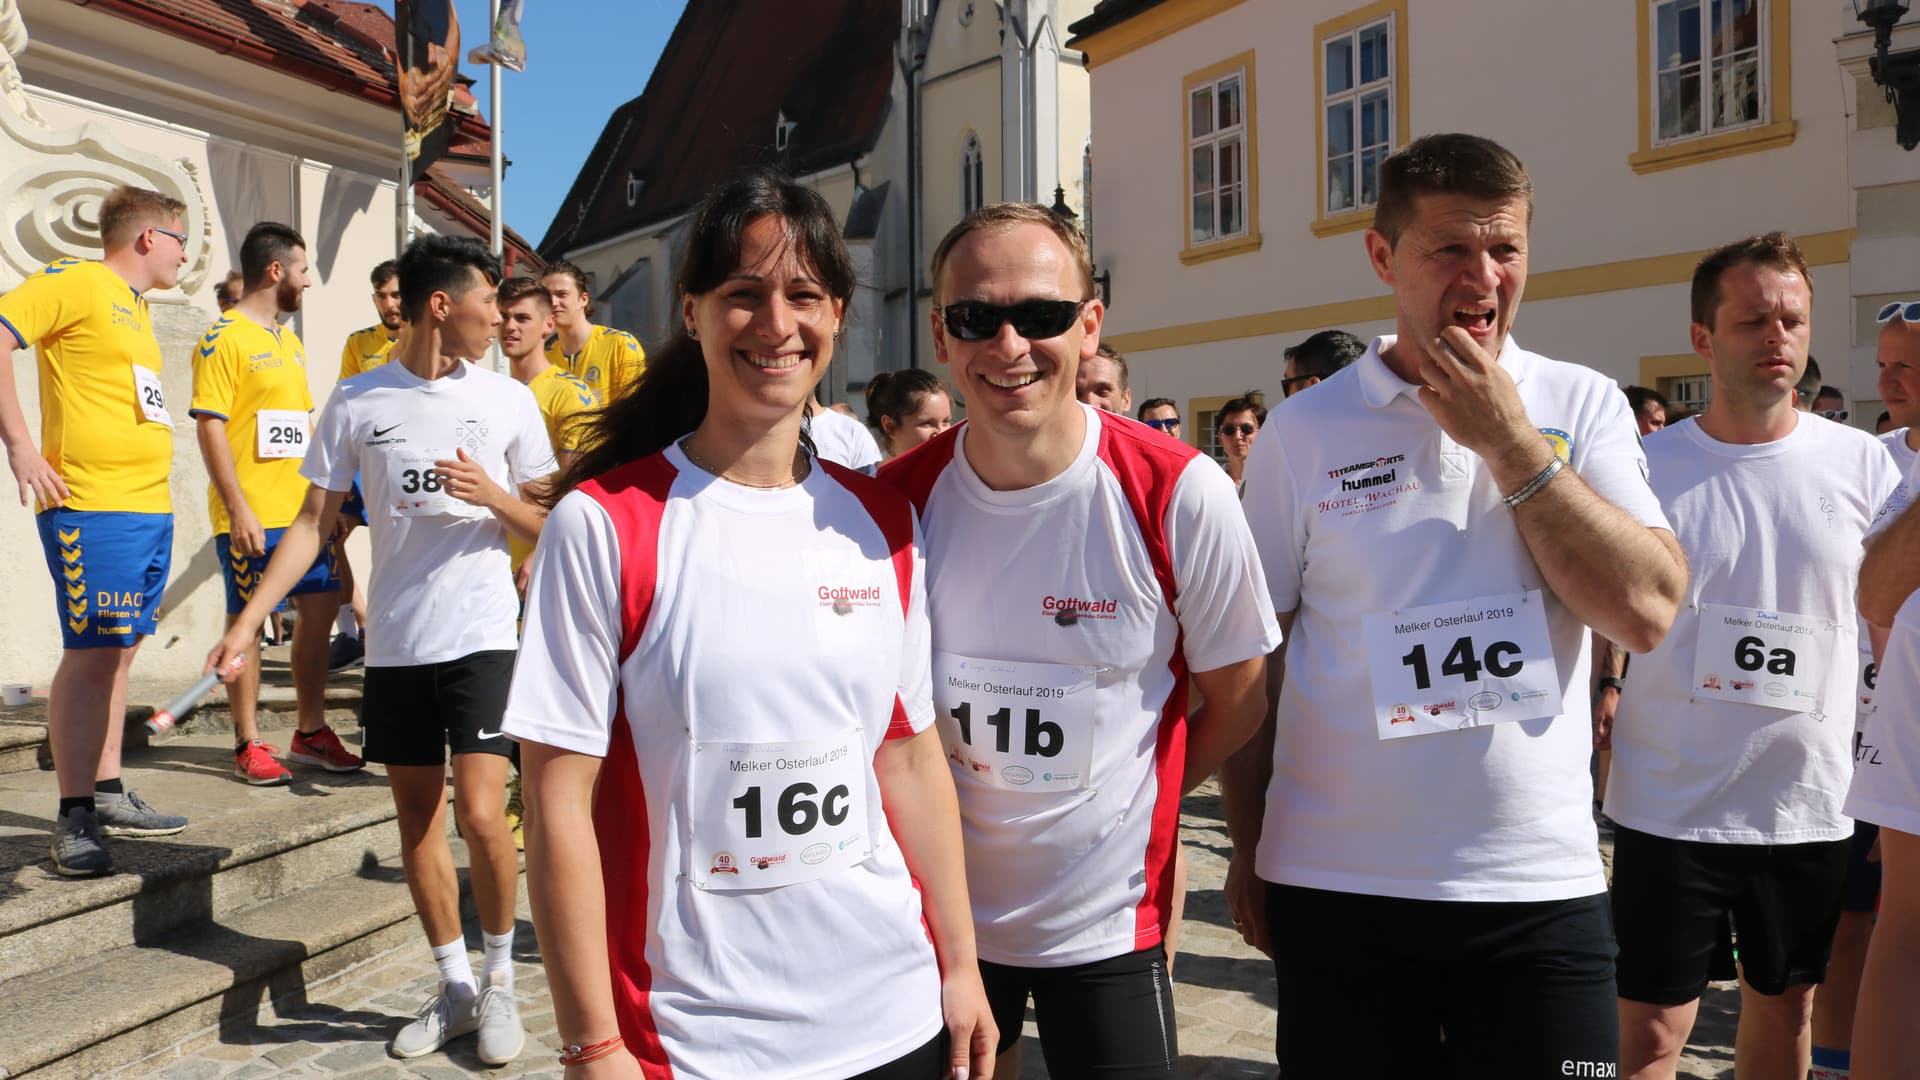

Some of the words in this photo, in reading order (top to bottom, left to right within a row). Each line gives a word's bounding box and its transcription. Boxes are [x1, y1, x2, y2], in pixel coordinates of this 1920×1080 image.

[269, 426, 303, 445] 29b
[1342, 468, 1397, 492] hummel
[1318, 497, 1360, 513] HOTEL
[1364, 482, 1421, 502] WACHAU
[817, 585, 881, 601] Gottwald
[1042, 595, 1118, 613] Gottwald
[1394, 622, 1432, 635] Melker
[1433, 611, 1484, 629] Osterlauf
[1486, 607, 1514, 620] 2019
[1724, 617, 1753, 627] Melker
[1754, 620, 1794, 633] Osterlauf
[1794, 625, 1815, 636] 2019
[1402, 635, 1524, 690] 14c
[1734, 635, 1797, 677] 6a
[948, 676, 981, 692] Melker
[983, 682, 1034, 696] Osterlauf
[1035, 687, 1064, 699] 2019
[950, 701, 1065, 758] 11b
[729, 759, 772, 773] Melker
[775, 754, 829, 771] Osterlauf
[829, 744, 849, 762] 2019
[732, 781, 850, 839] 16c
[718, 855, 730, 864] 40
[750, 854, 786, 865] Gottwald
